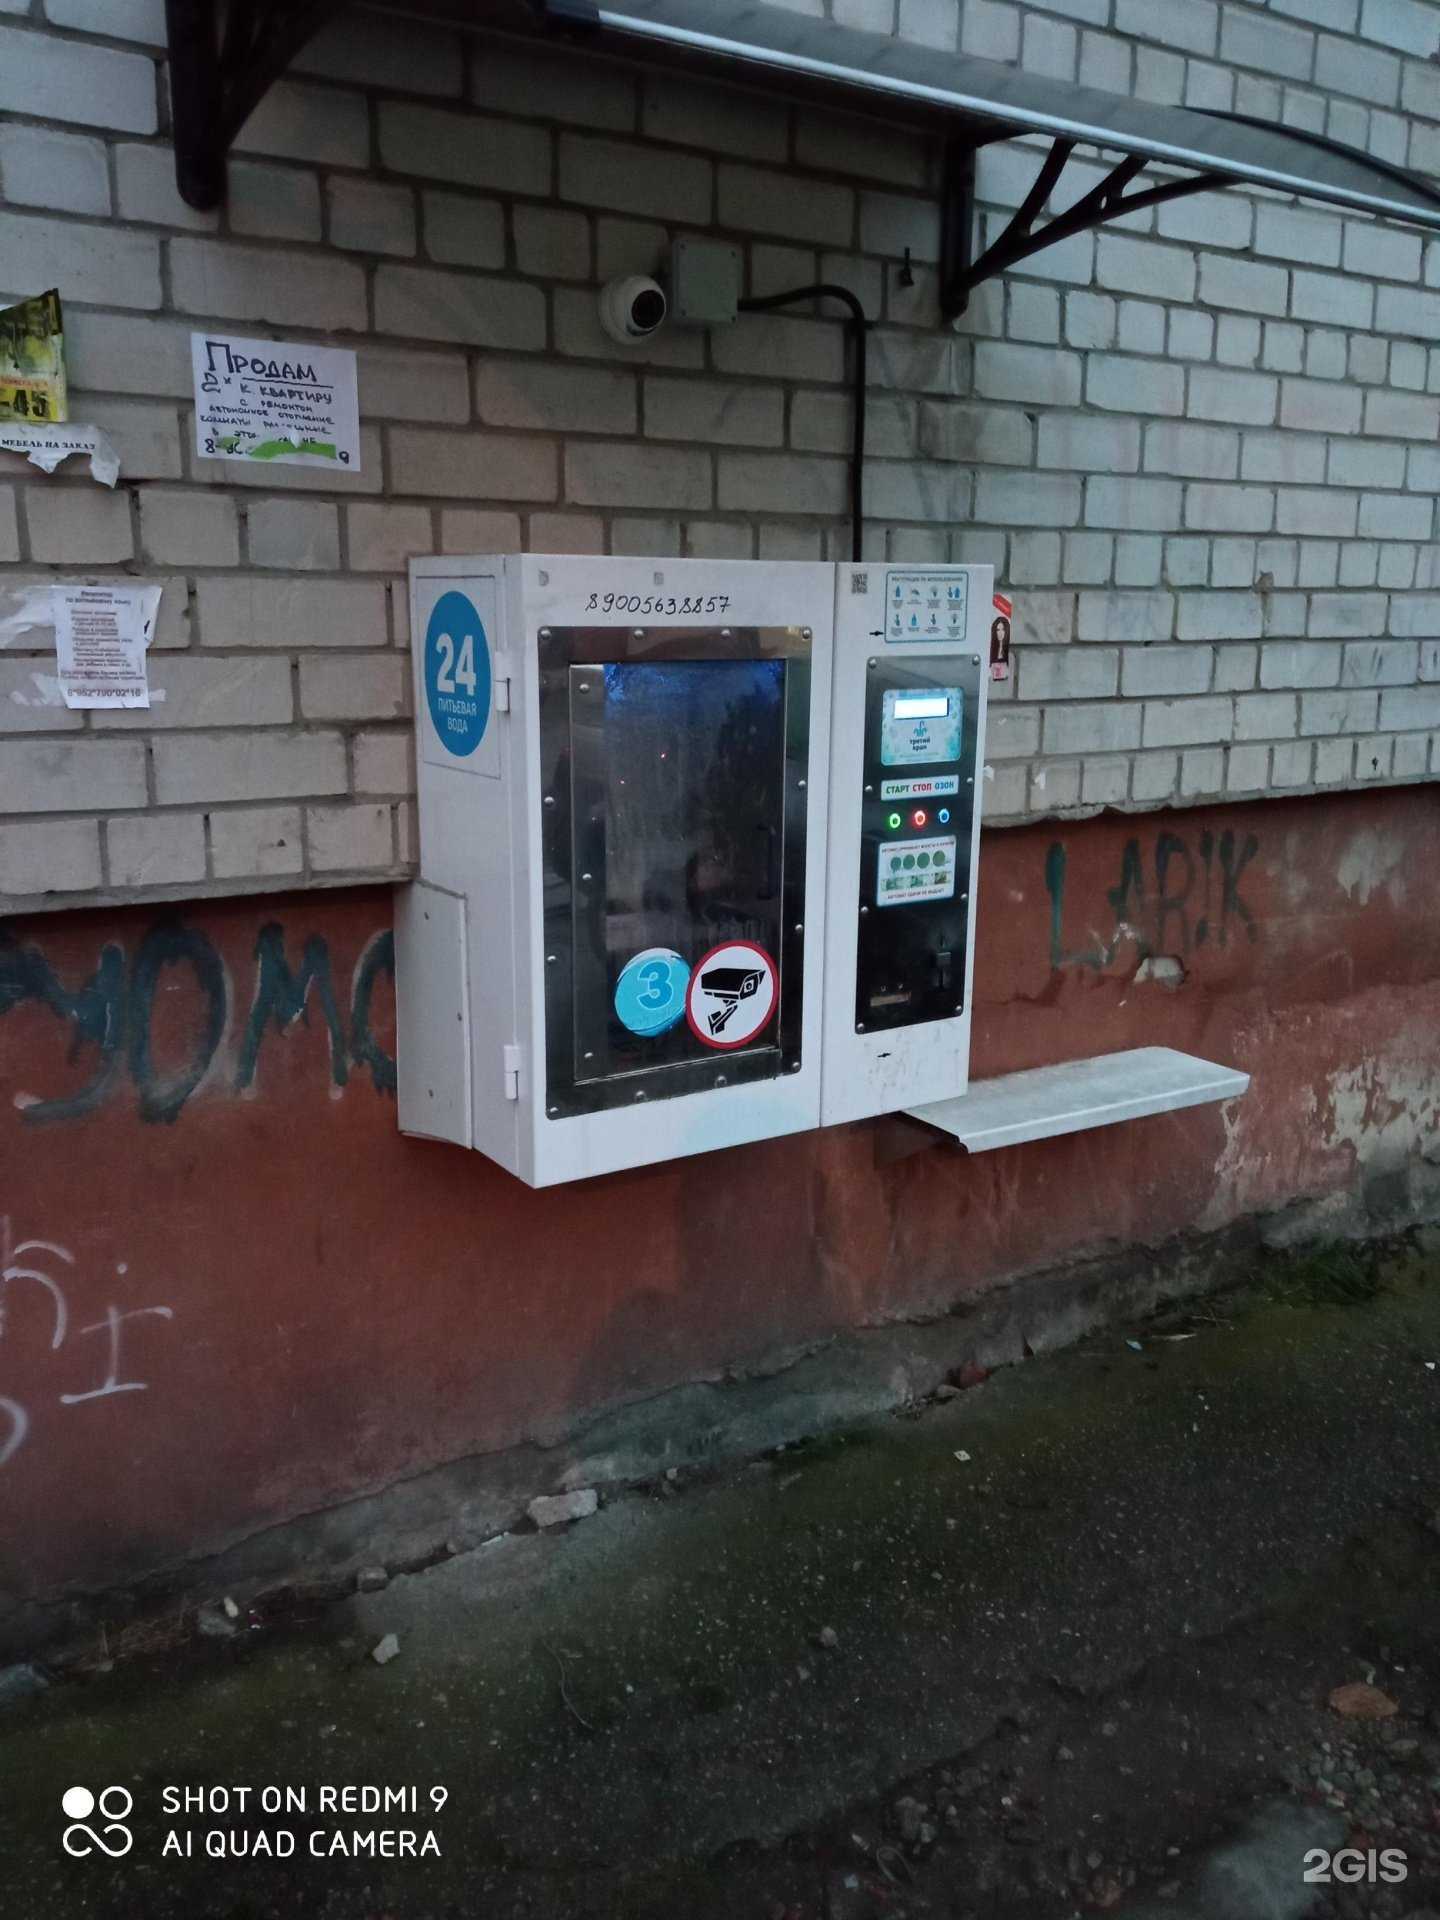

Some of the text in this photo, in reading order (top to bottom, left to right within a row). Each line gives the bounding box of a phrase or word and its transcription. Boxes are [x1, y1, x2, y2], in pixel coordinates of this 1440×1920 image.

[205, 341, 317, 382] ПРОДАМ
[260, 386, 332, 404] КВАРТИРУ
[2, 439, 42, 448] МЕБЕЛЬ
[61, 442, 95, 450] ЗАКАЗ
[585, 592, 731, 615] 89005638857
[436, 633, 477, 697] 24
[438, 699, 477, 716] ПИТЬЕВАЯ
[447, 717, 469, 733] ВОДА
[886, 781, 954, 794] СТАРТ СТОП ОЗОН
[636, 960, 674, 1010] 3
